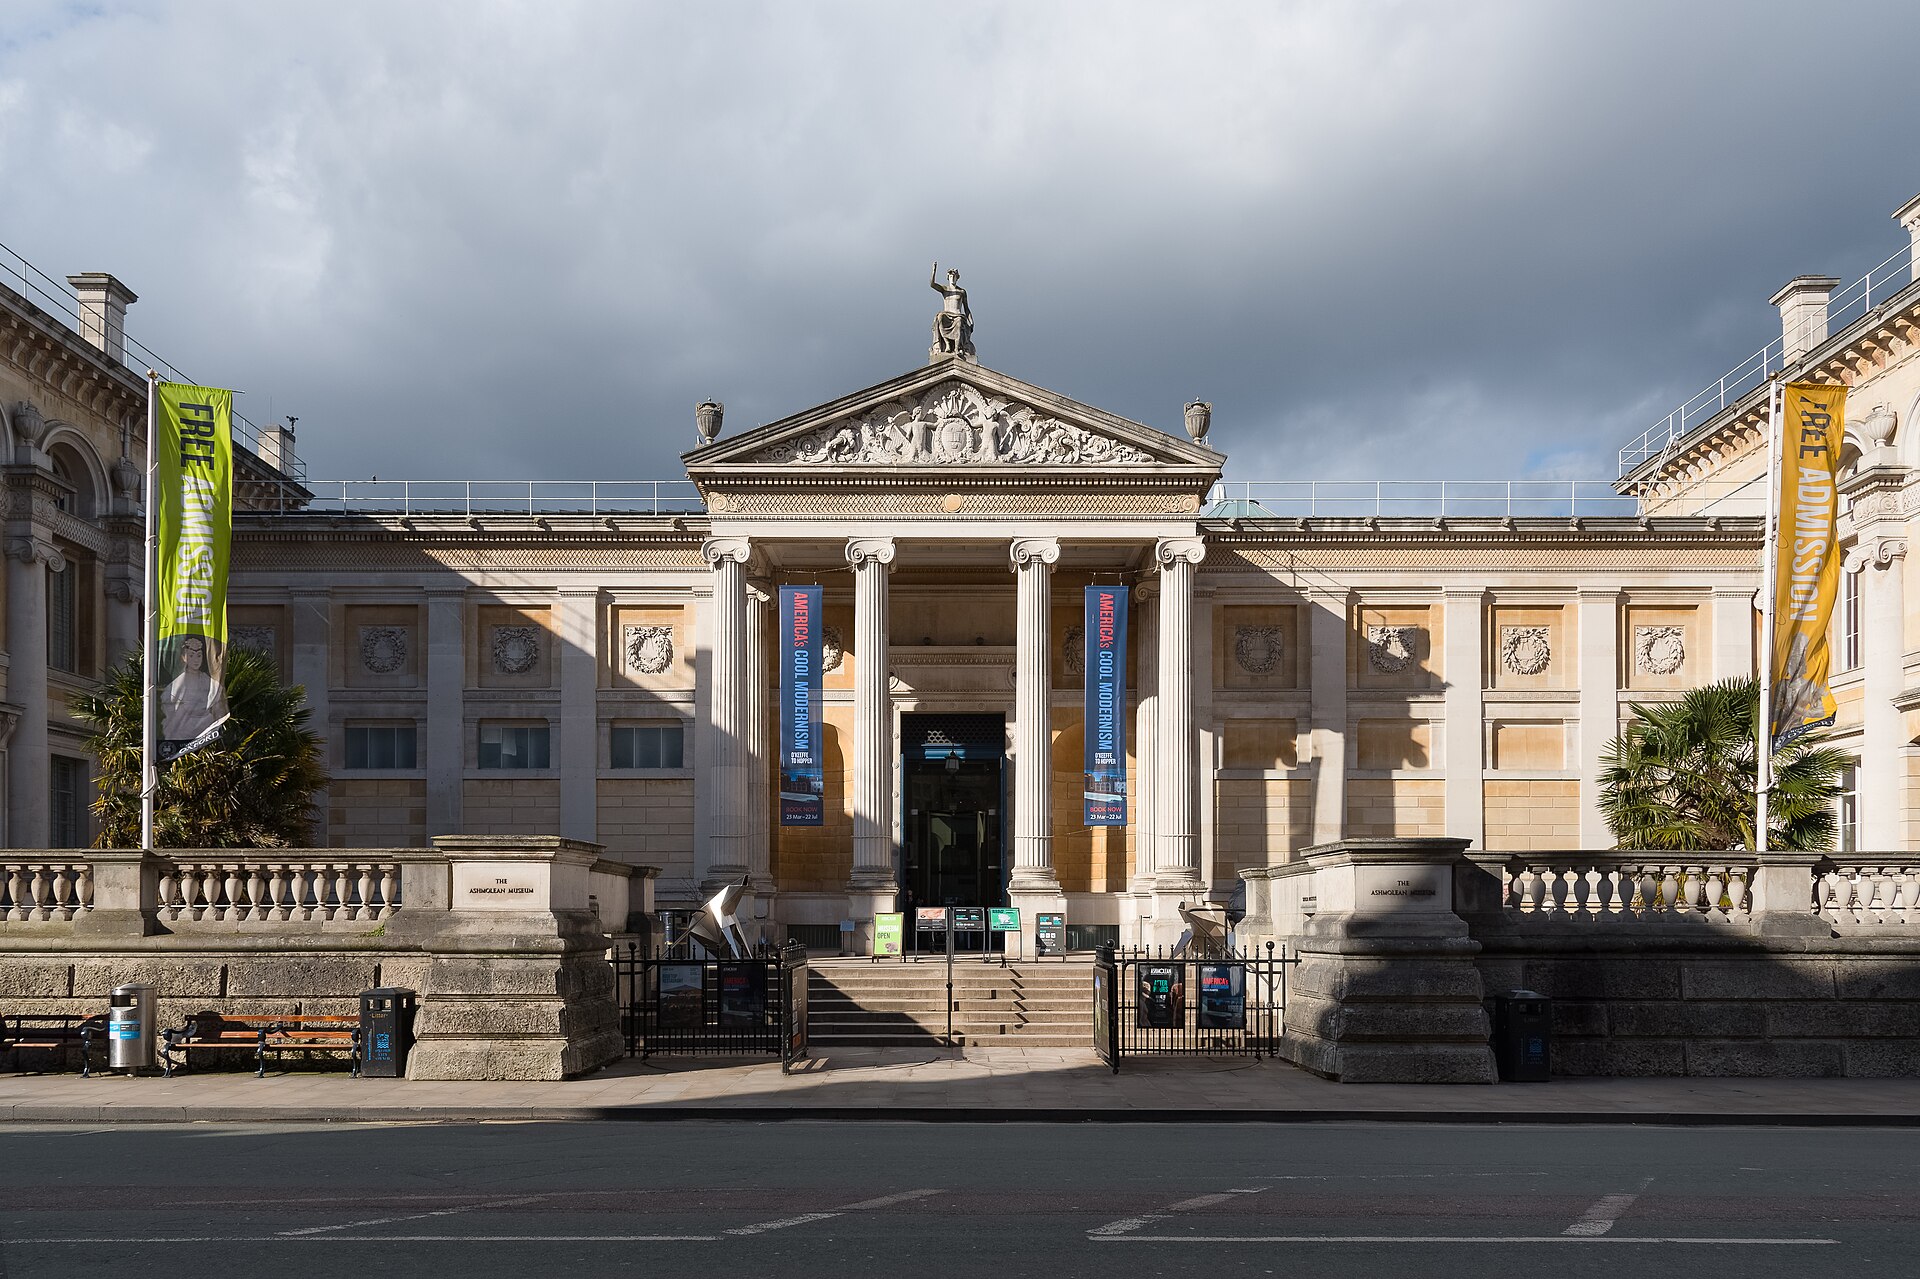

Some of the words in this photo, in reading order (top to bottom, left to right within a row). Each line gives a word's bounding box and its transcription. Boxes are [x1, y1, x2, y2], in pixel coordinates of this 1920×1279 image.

[179, 402, 215, 470] FREE
[1799, 396, 1831, 459] FREE
[176, 474, 215, 626] ADMISSION
[1790, 466, 1831, 621] ADMISSION
[794, 592, 809, 648] AMERICA's
[1100, 593, 1114, 649] AMERICA's
[794, 650, 809, 679] COOL
[1099, 651, 1113, 680] COOL
[179, 730, 219, 753] OXFORD
[794, 681, 809, 750] MODERNISM
[1098, 682, 1113, 750] MODERNISM
